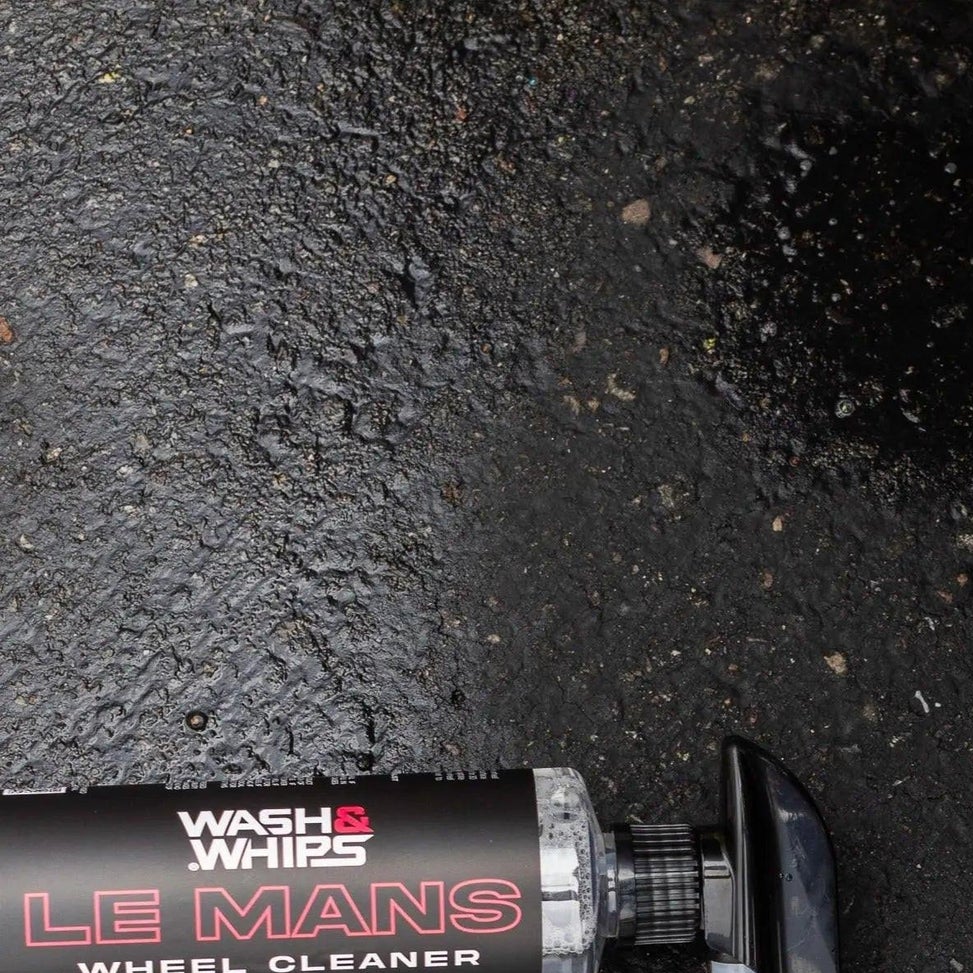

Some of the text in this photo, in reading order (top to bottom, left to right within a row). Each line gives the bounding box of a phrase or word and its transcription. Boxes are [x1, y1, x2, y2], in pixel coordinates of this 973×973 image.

[24, 878, 523, 947] LE MANS
[268, 949, 480, 973] CLEANER
